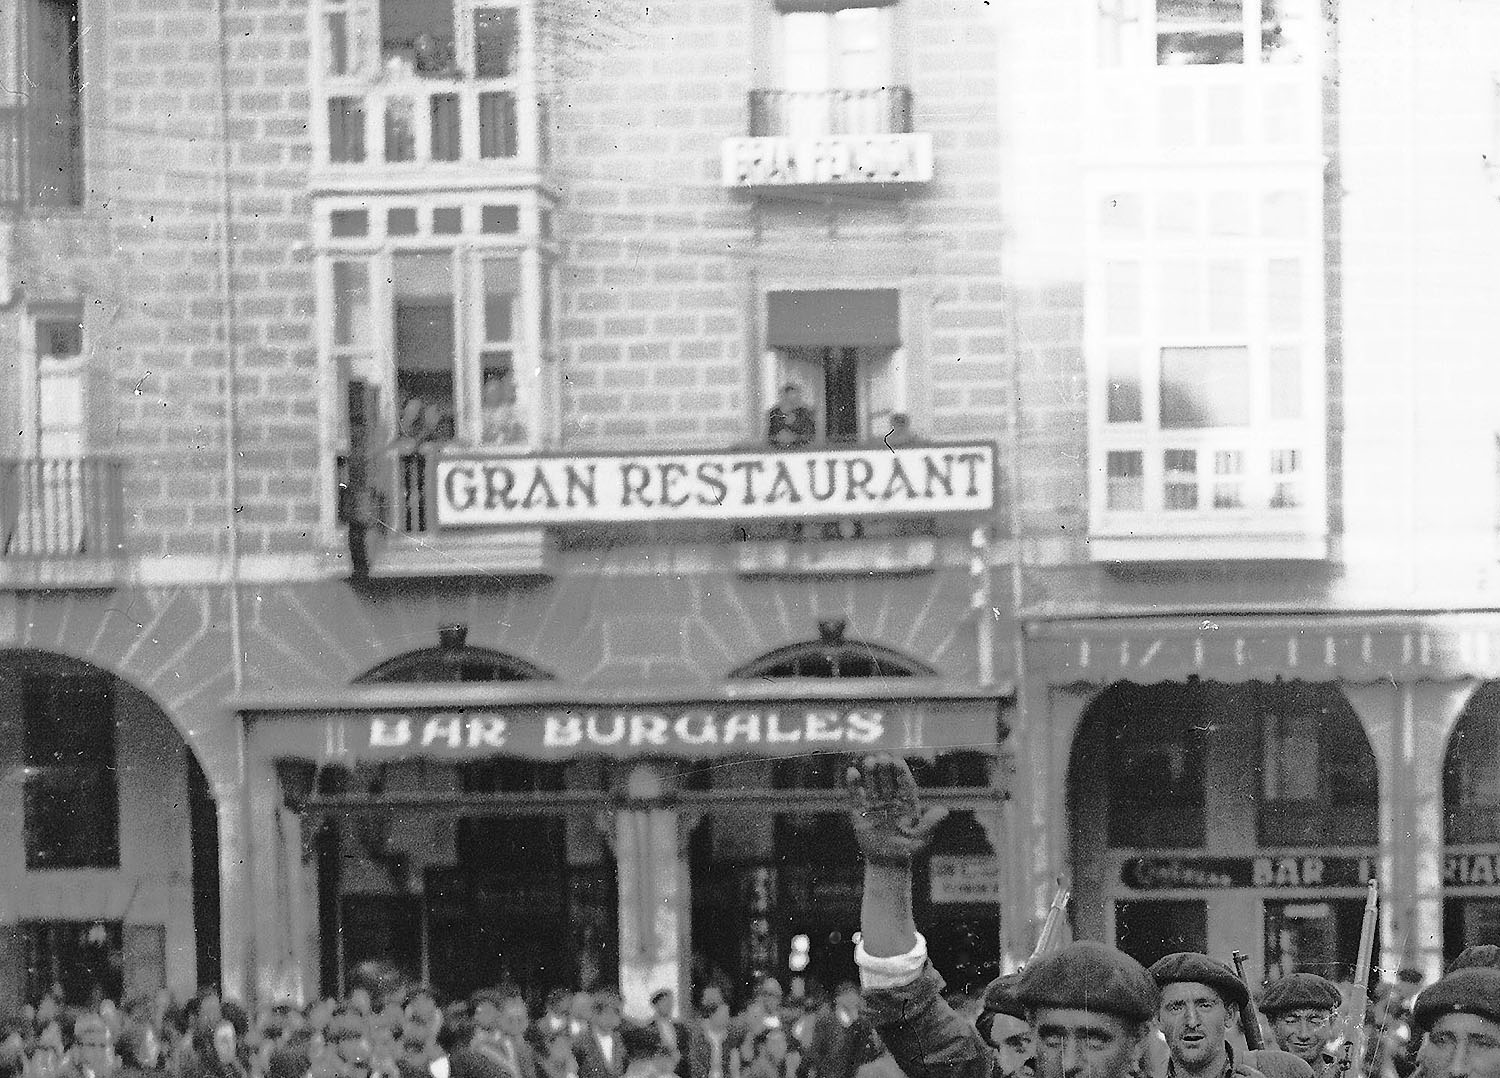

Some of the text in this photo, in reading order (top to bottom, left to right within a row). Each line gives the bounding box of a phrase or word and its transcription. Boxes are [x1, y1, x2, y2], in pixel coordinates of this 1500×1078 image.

[442, 452, 988, 511] GRAN RESTAURANT
[369, 710, 886, 748] BAR BURGALES
[1253, 858, 1325, 886] BAR
